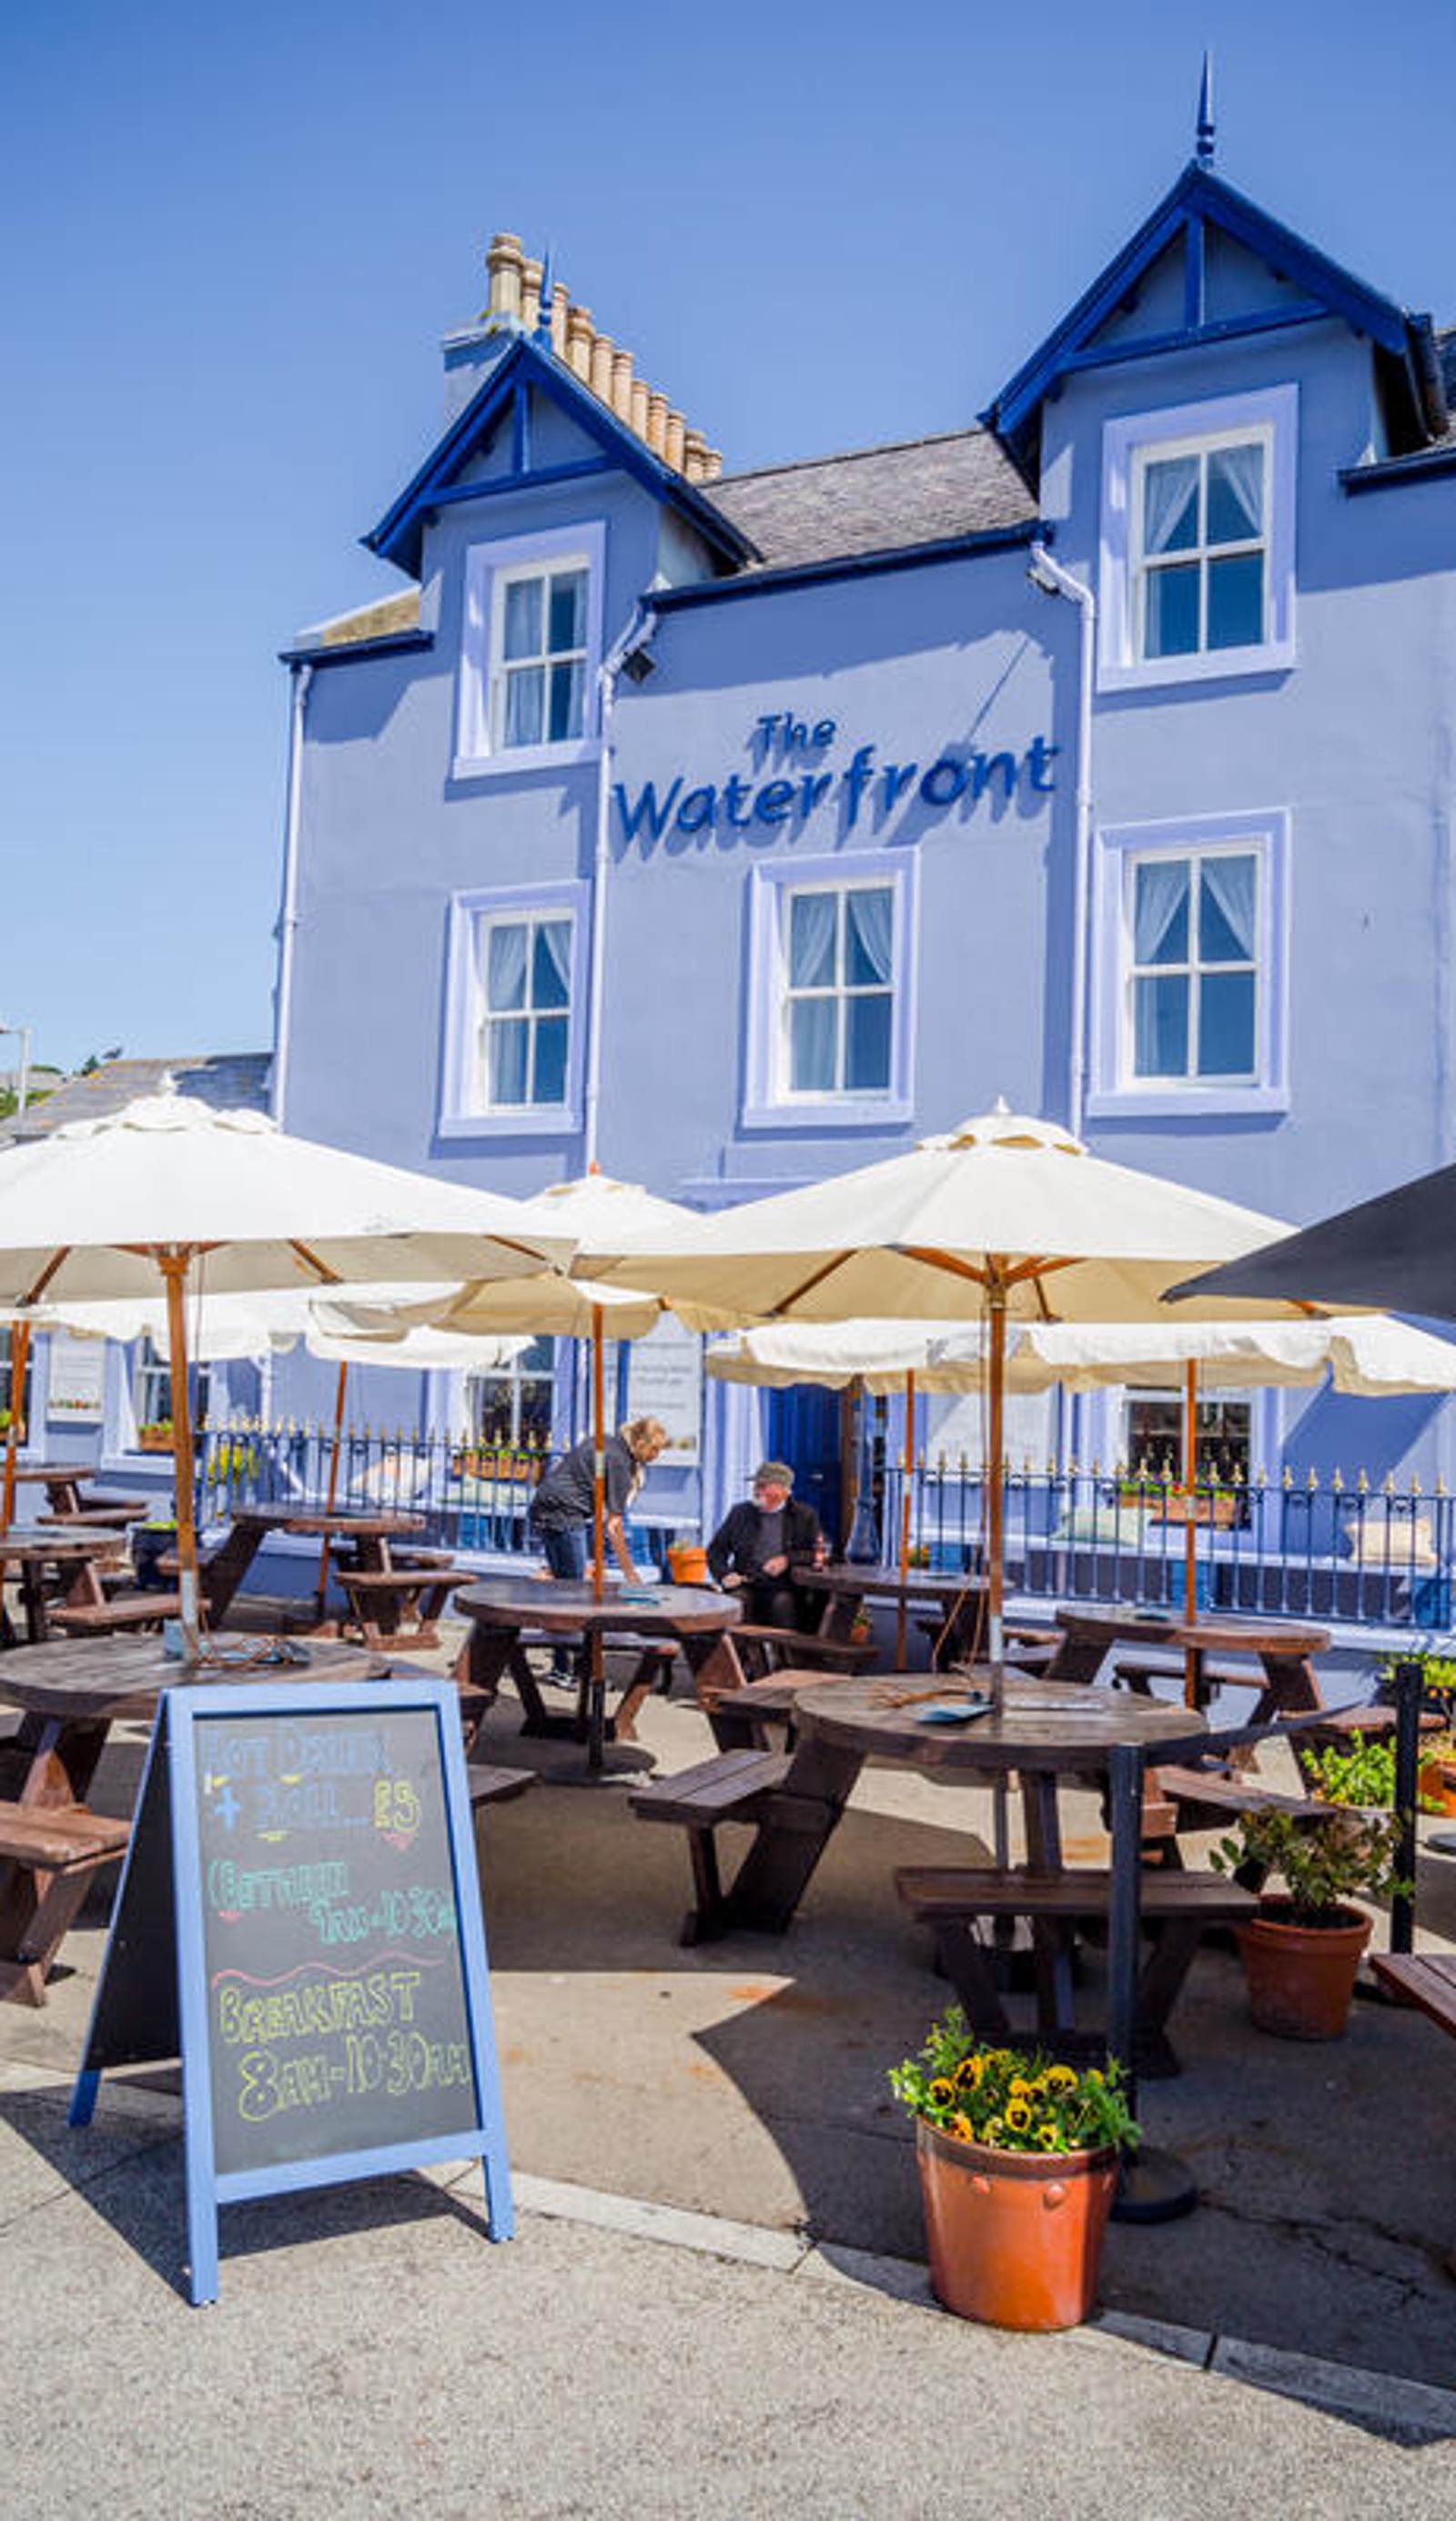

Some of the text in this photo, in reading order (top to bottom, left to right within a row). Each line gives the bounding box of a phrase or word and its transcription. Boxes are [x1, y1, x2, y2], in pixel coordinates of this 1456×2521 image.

[758, 712, 836, 752] The
[612, 735, 1058, 843] Waterfront
[219, 1971, 421, 2044] BREAKFAST
